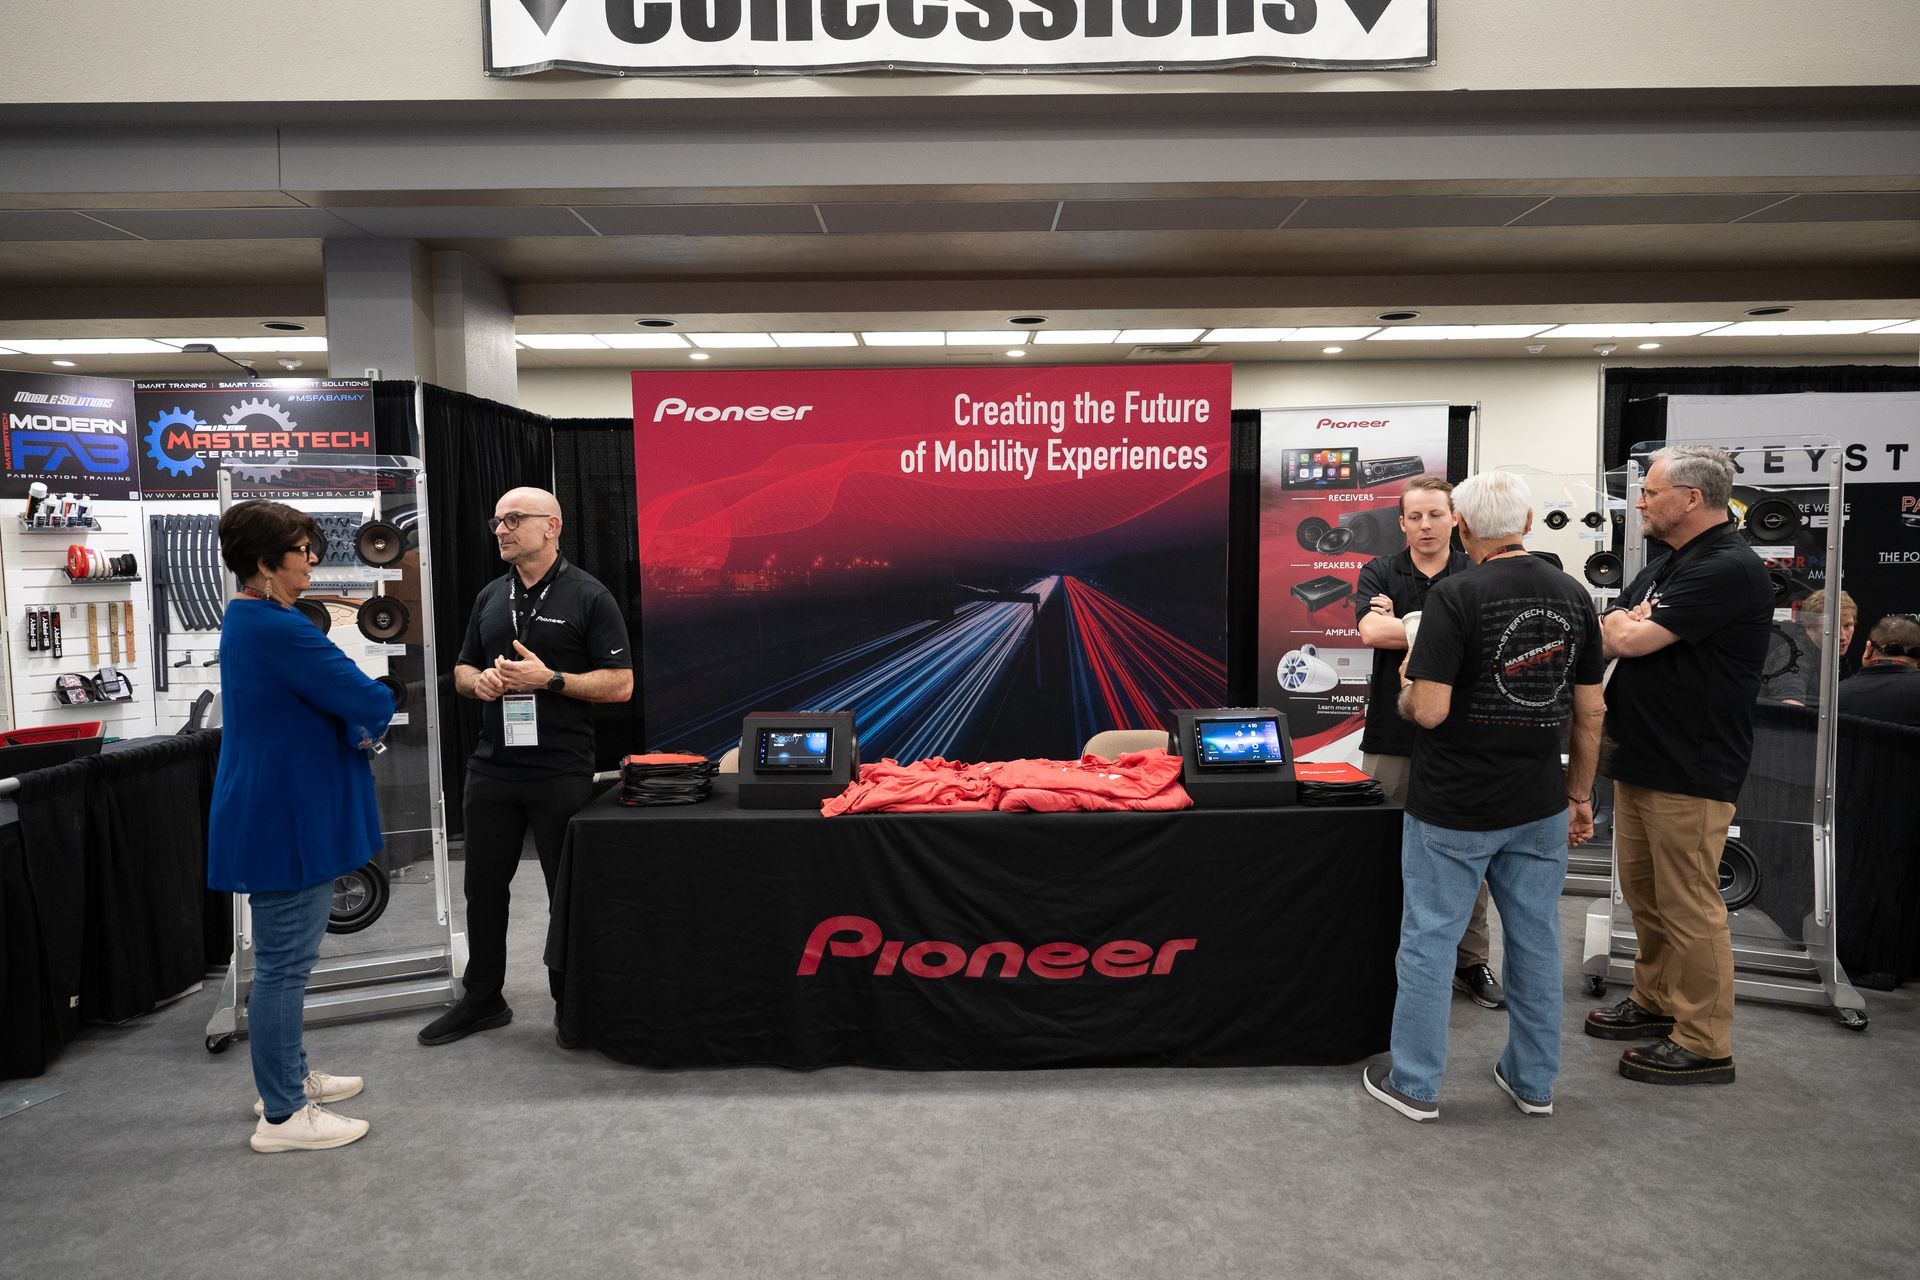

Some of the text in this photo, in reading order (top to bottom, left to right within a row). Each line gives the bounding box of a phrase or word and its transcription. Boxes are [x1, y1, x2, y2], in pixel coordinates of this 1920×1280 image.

[287, 394, 364, 402] #MSFABARMY
[653, 397, 813, 423] Pioneer
[954, 391, 1210, 433] Creating the Future
[9, 413, 127, 434] MODERN
[1316, 418, 1390, 429] Pioneer
[2, 412, 12, 470] MASTERTECH
[167, 430, 369, 449] MASTERTECH
[11, 431, 129, 473] FAB
[195, 450, 299, 458] CERTIFIED
[900, 437, 1208, 480] of Mobility Experiences
[144, 490, 375, 498] WWW.MOBISOLUTIONS-USA.COM
[1328, 494, 1374, 502] RECEIVERS
[1878, 552, 1900, 562] THE
[535, 615, 566, 624] Pioneer
[1494, 608, 1544, 660] MASTERTECH
[1546, 610, 1571, 632] EXPO
[1504, 639, 1565, 668] MASTERTECH
[1331, 695, 1365, 703] MARINE
[796, 915, 1197, 979] Pioneer
